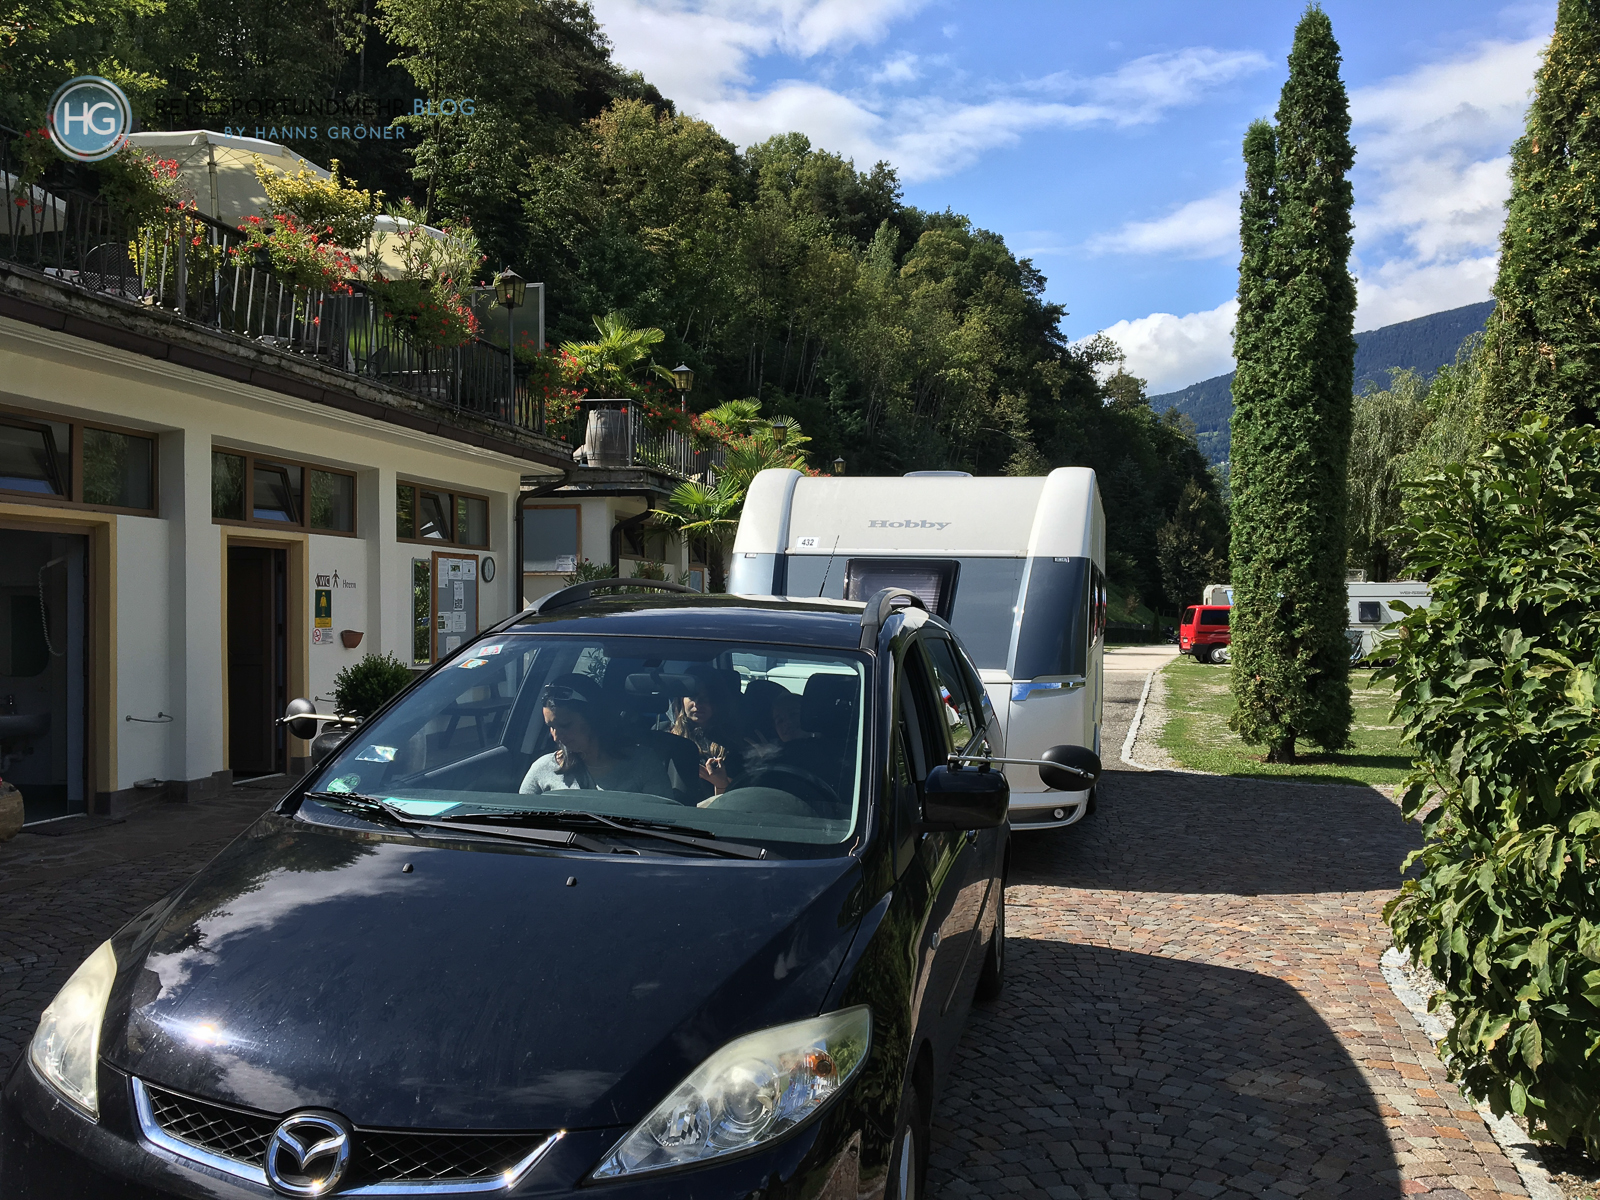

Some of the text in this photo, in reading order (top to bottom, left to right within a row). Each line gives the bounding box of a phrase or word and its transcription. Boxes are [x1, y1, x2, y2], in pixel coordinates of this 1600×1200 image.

[868, 519, 952, 531] Hobby
[801, 538, 815, 547] 432
[319, 576, 330, 586] WC
